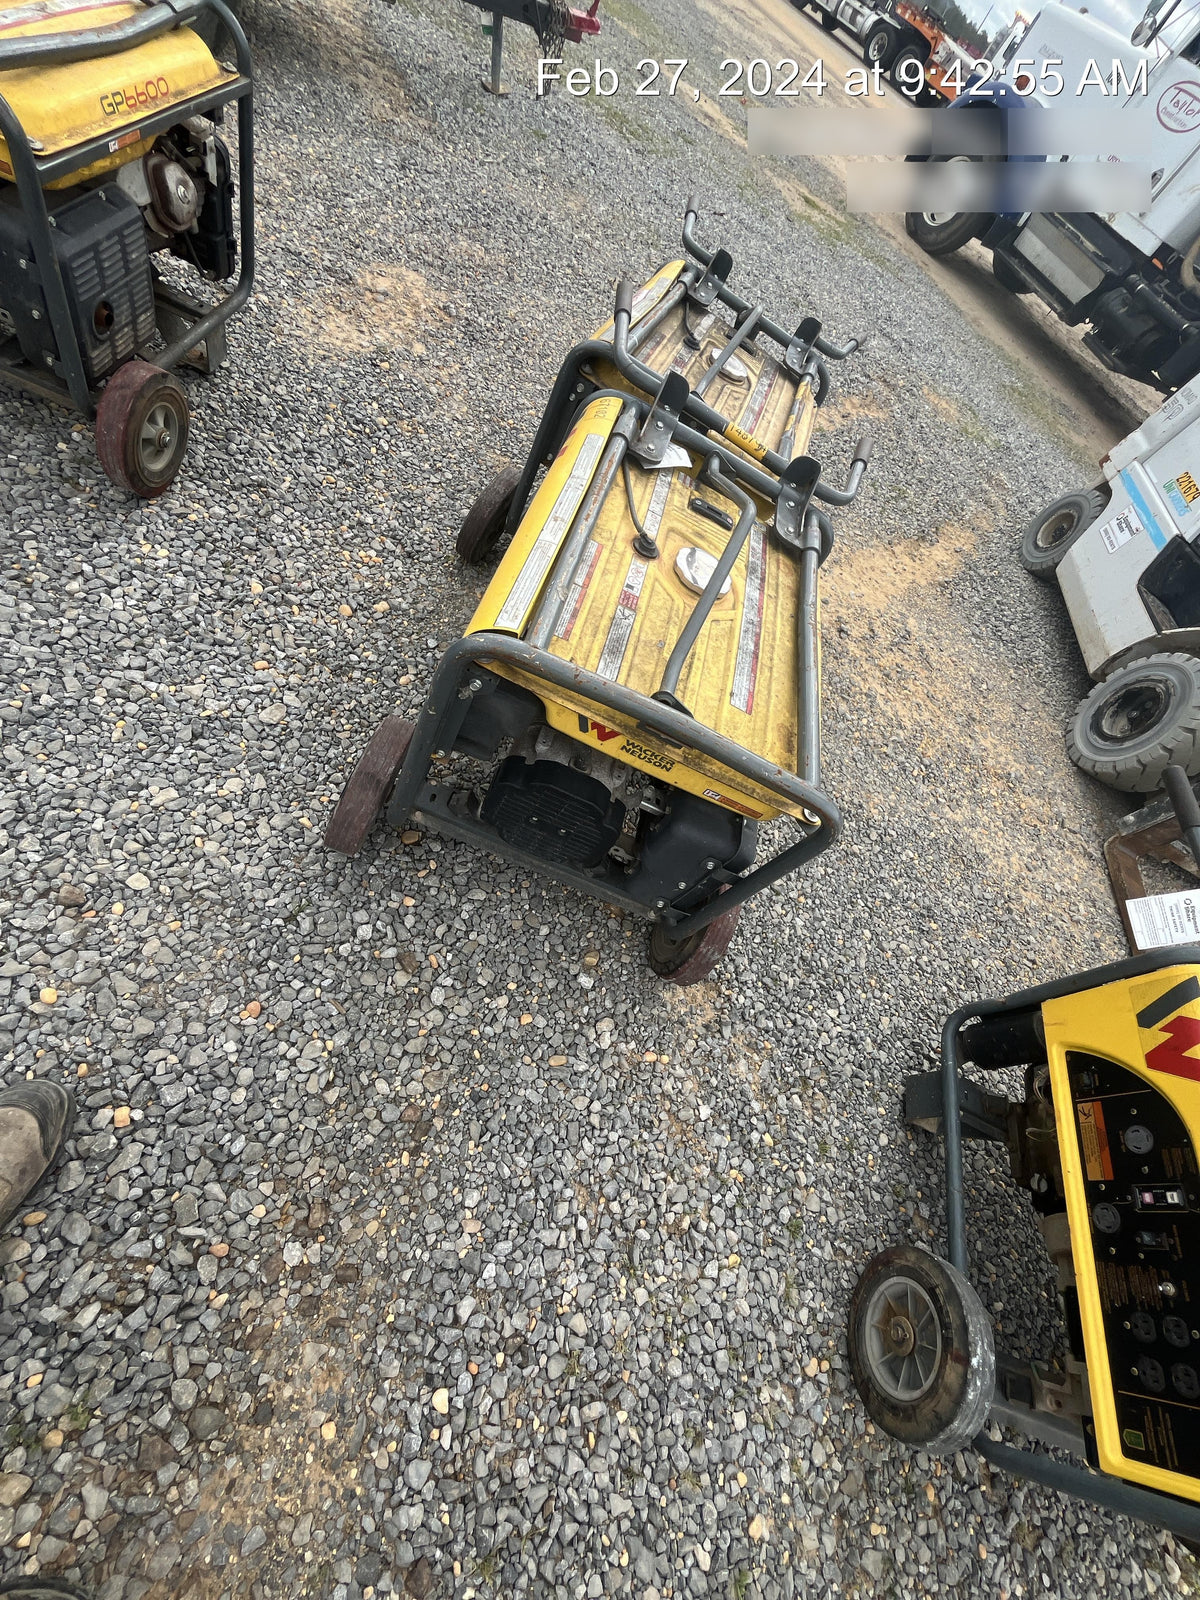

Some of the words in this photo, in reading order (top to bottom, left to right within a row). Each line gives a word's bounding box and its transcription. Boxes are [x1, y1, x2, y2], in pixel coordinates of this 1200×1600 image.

[99, 76, 170, 117] GP6600
[620, 745, 673, 773] NEUSON
[625, 739, 676, 767] WACKER
[1184, 906, 1192, 923] Share
[1190, 905, 1200, 935] Equipment
